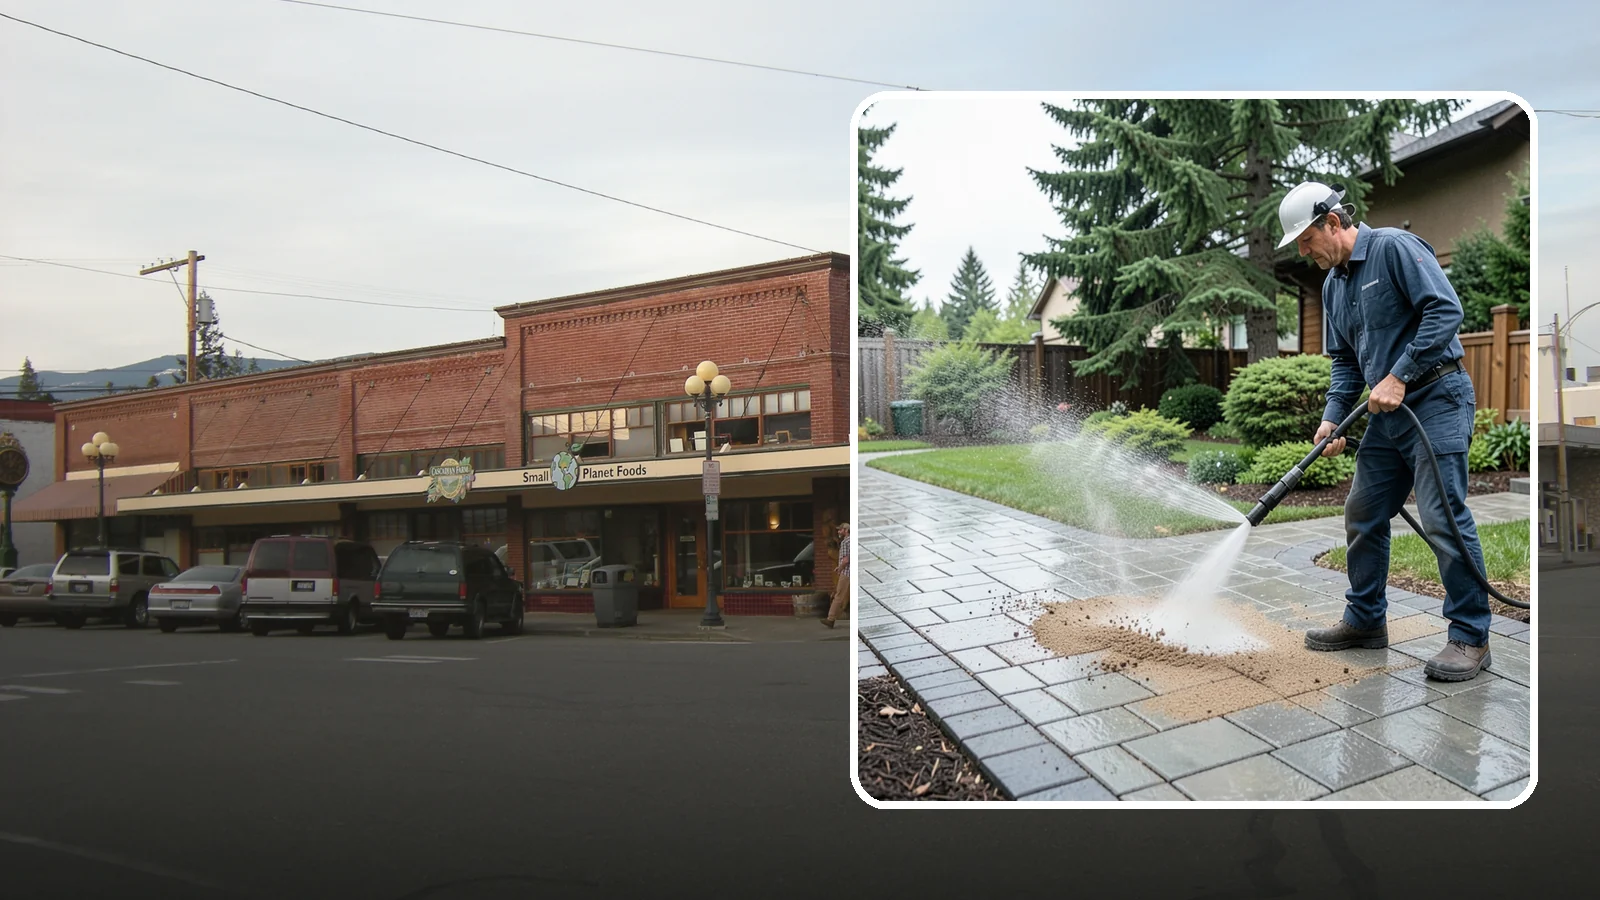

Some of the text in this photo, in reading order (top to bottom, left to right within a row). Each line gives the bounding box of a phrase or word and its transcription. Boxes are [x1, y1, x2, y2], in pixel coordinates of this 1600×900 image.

[523, 464, 647, 483] Small Planet Foods
